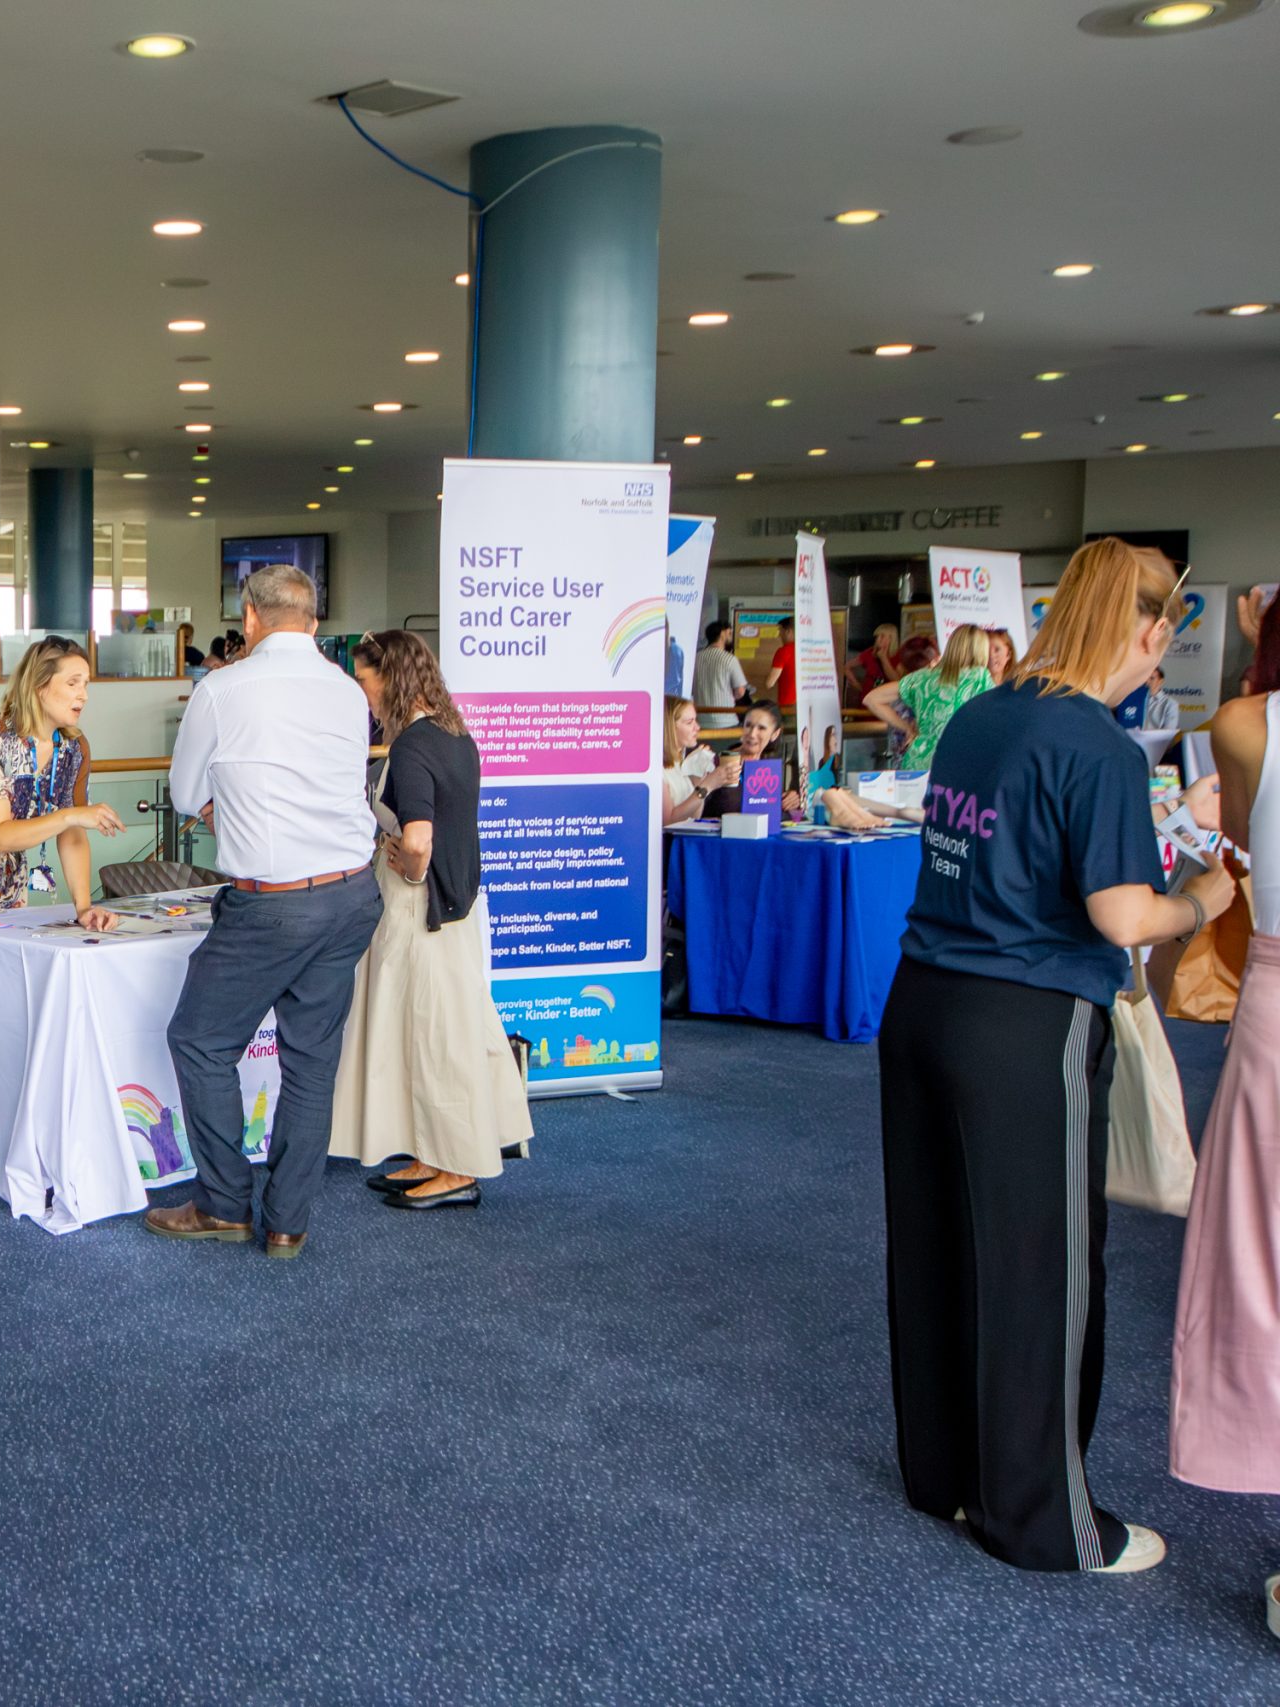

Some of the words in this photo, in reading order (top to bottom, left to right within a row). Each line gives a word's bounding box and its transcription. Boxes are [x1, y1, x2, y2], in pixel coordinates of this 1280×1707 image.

[624, 482, 653, 496] NHS
[581, 498, 608, 507] Norfolk
[610, 499, 625, 507] and
[626, 498, 653, 507] Suffolk
[912, 506, 1001, 530] COFFEE
[459, 546, 523, 568] NSFT
[665, 573, 695, 586] lematic
[939, 565, 972, 589] ACT
[459, 575, 545, 599] Service
[552, 576, 604, 599] User
[459, 606, 503, 628] and
[510, 606, 572, 628] Carer
[459, 635, 546, 657] Council
[466, 703, 512, 714] Trust-wide
[513, 703, 540, 713] forum
[542, 703, 560, 713] that
[562, 703, 589, 714] brings
[591, 703, 628, 714] together
[490, 716, 507, 726] with
[509, 715, 530, 725] lived
[532, 715, 581, 727] experience
[583, 714, 592, 724] of
[593, 714, 623, 724] mental
[487, 728, 503, 738] and
[505, 728, 541, 740] learning
[542, 727, 582, 739] disability
[584, 727, 620, 737] services
[477, 741, 504, 751] hether
[505, 742, 516, 750] as
[518, 740, 551, 750] service
[552, 741, 580, 751] users,
[582, 740, 611, 751] carers,
[612, 739, 623, 748] or
[486, 754, 529, 763] members.
[480, 799, 492, 807] we
[493, 797, 508, 807] do:
[926, 784, 998, 839] TYAc
[508, 818, 522, 827] the
[524, 817, 553, 826] voices
[555, 816, 565, 826] of
[566, 815, 598, 825] service
[599, 815, 623, 824] users
[503, 829, 513, 838] at
[514, 827, 525, 838] all
[526, 827, 553, 837] levels
[554, 826, 565, 836] of
[565, 826, 580, 836] the
[582, 826, 606, 835] Trust.
[925, 826, 970, 859] Network
[480, 851, 508, 861] tribute
[509, 851, 518, 860] to
[520, 849, 552, 859] service
[554, 847, 587, 860] design,
[588, 846, 614, 858] policy
[480, 862, 514, 873] opment,
[515, 860, 533, 870] and
[534, 858, 565, 871] quality
[566, 857, 625, 869] improvement.
[930, 851, 961, 880] Team
[488, 881, 528, 892] feedback
[530, 881, 551, 891] from
[552, 879, 574, 890] local
[576, 878, 593, 888] and
[594, 877, 629, 887] national
[500, 912, 542, 924] inclusive,
[544, 911, 579, 922] diverse,
[581, 910, 598, 920] and
[496, 923, 554, 936] participation.
[511, 947, 517, 955] a
[518, 944, 543, 955] Safer,
[545, 942, 577, 953] Kinder,
[579, 941, 606, 951] Better
[606, 939, 632, 950] NSFT.
[534, 997, 572, 1008] together
[525, 1009, 561, 1021] Kinder
[569, 1007, 602, 1018] Better
[258, 1029, 275, 1041] tog
[247, 1041, 279, 1059] Kinde
